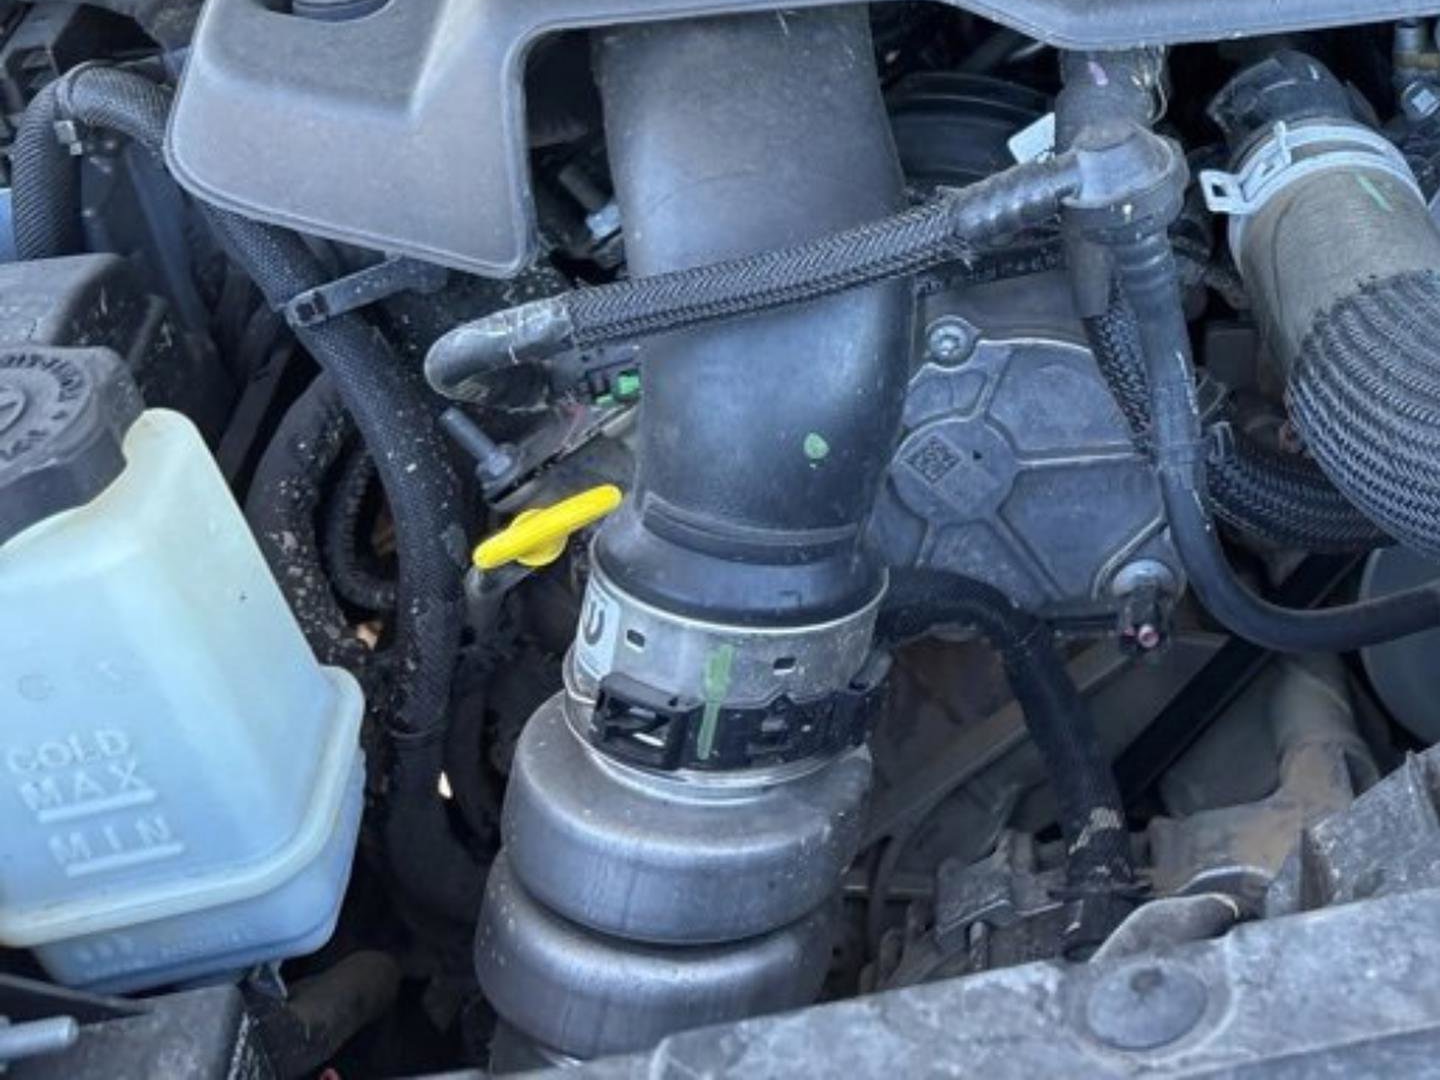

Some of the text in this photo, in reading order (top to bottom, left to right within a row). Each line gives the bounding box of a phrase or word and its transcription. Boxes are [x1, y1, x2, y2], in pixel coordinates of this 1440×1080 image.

[7, 729, 130, 771] COLD
[20, 761, 150, 811] MAX
[48, 815, 171, 865] MIN
